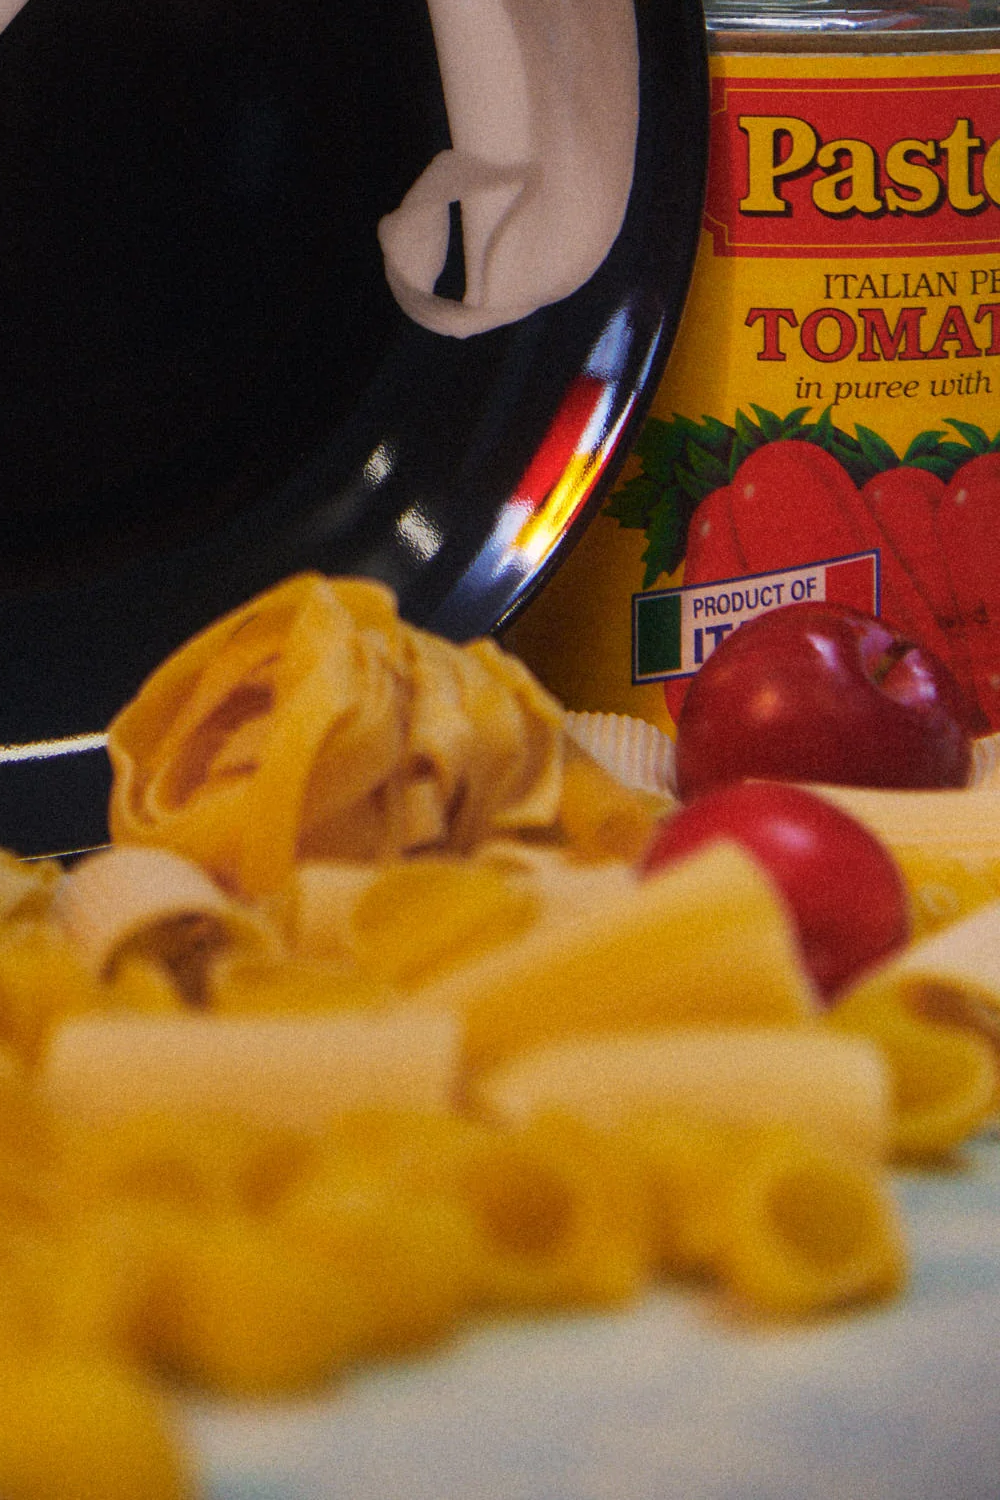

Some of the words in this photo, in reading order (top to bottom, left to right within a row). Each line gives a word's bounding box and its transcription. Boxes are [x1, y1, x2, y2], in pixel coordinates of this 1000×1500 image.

[824, 271, 958, 299] ITALIAN
[795, 376, 823, 399] in
[833, 380, 920, 405] puree
[930, 370, 993, 397] with
[693, 583, 785, 619] PRODUCT
[790, 577, 818, 601] OF
